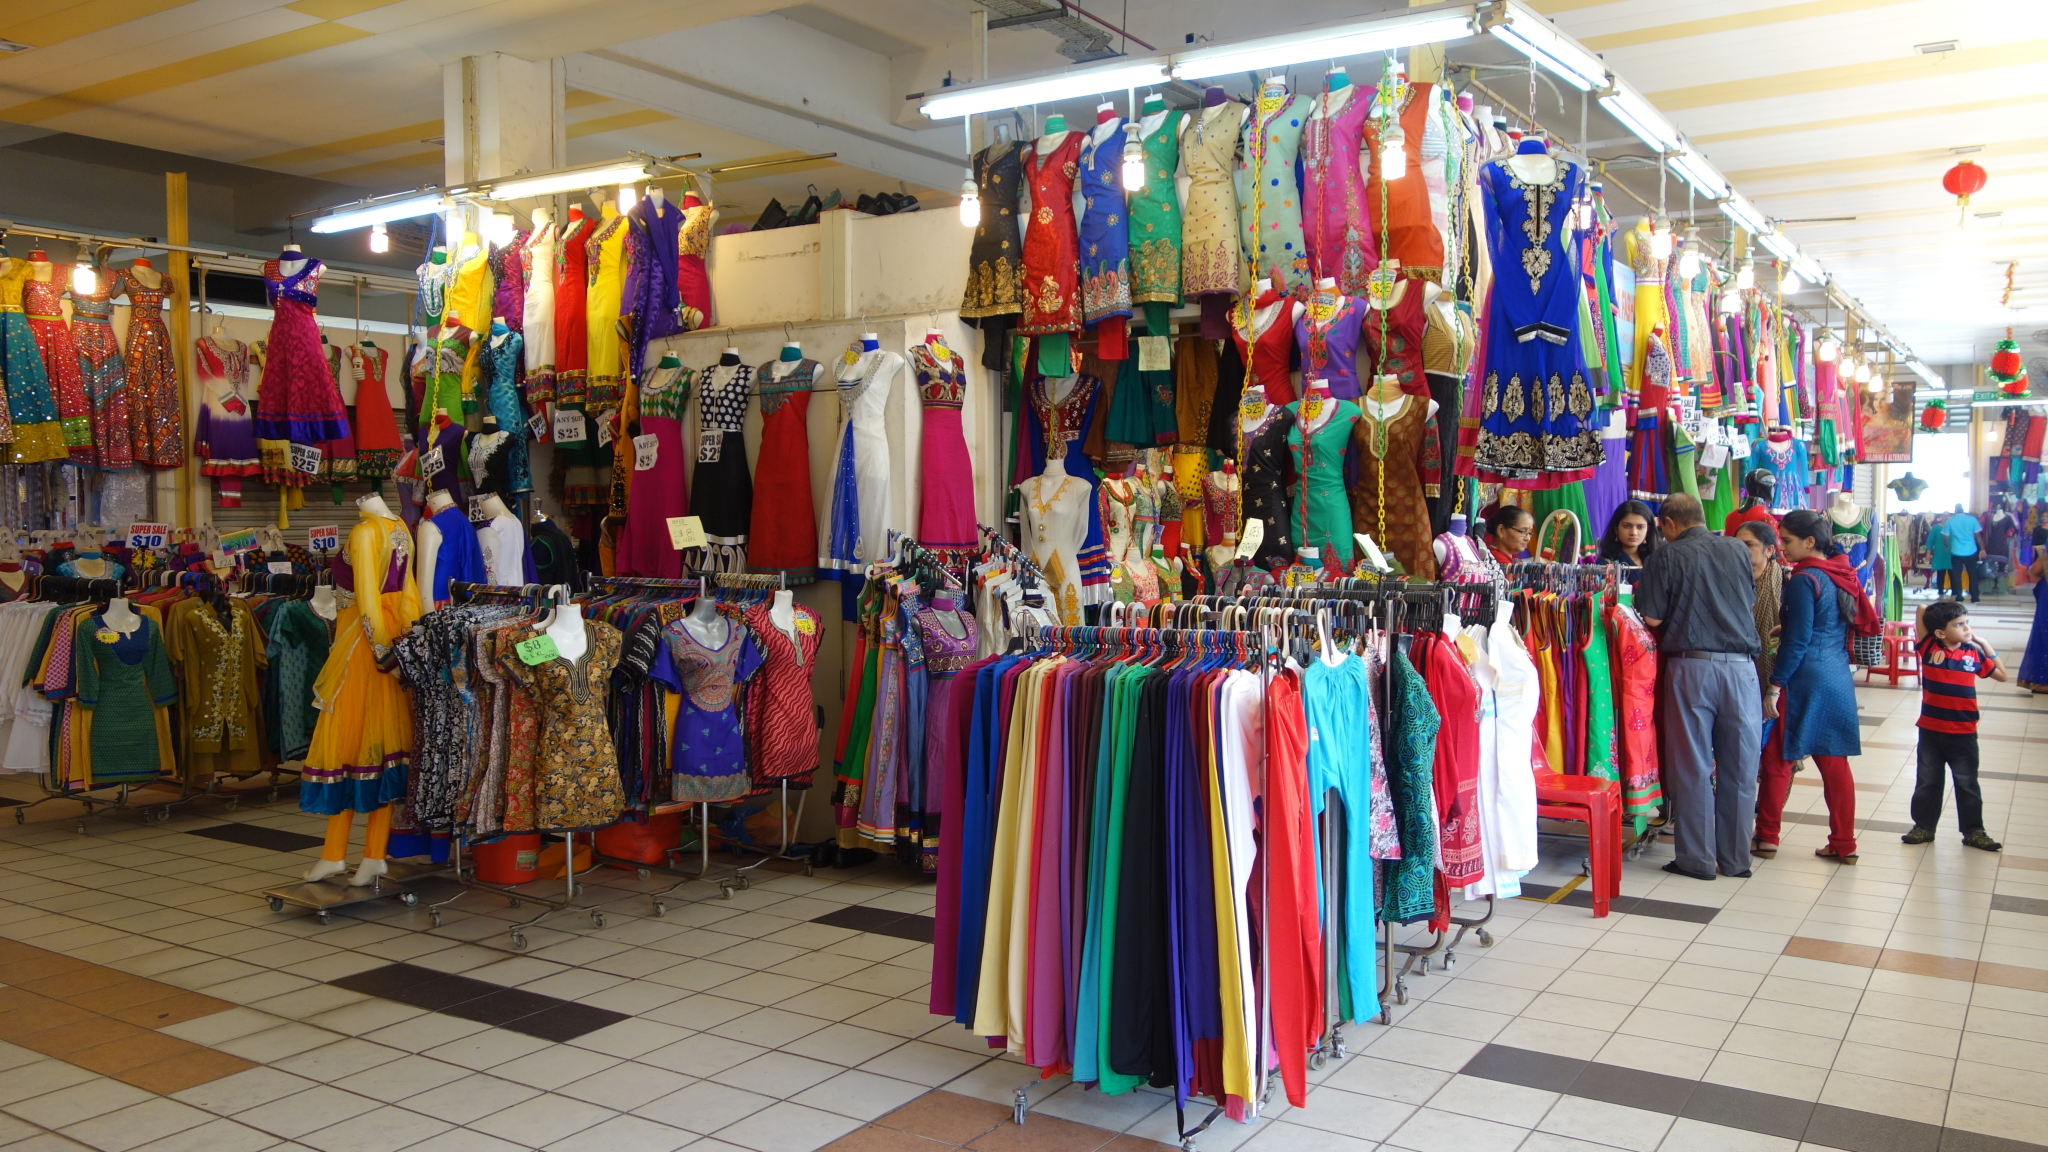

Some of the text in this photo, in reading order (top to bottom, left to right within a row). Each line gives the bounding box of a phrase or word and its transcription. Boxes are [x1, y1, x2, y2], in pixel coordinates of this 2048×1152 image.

[1975, 392, 1990, 400] EXIT
[557, 427, 579, 440] $25
[639, 441, 650, 450] ANY
[290, 445, 321, 462] SUPER SALE
[1888, 453, 1910, 461] ALTERATION
[291, 455, 316, 473] $25
[423, 458, 443, 478] $25
[131, 525, 167, 534] SUPER SALE
[310, 527, 337, 538] SUPER SALE
[131, 534, 162, 547] $10
[312, 536, 336, 550] $10
[1361, 571, 1379, 583] $25
[1928, 650, 1946, 665] 10
